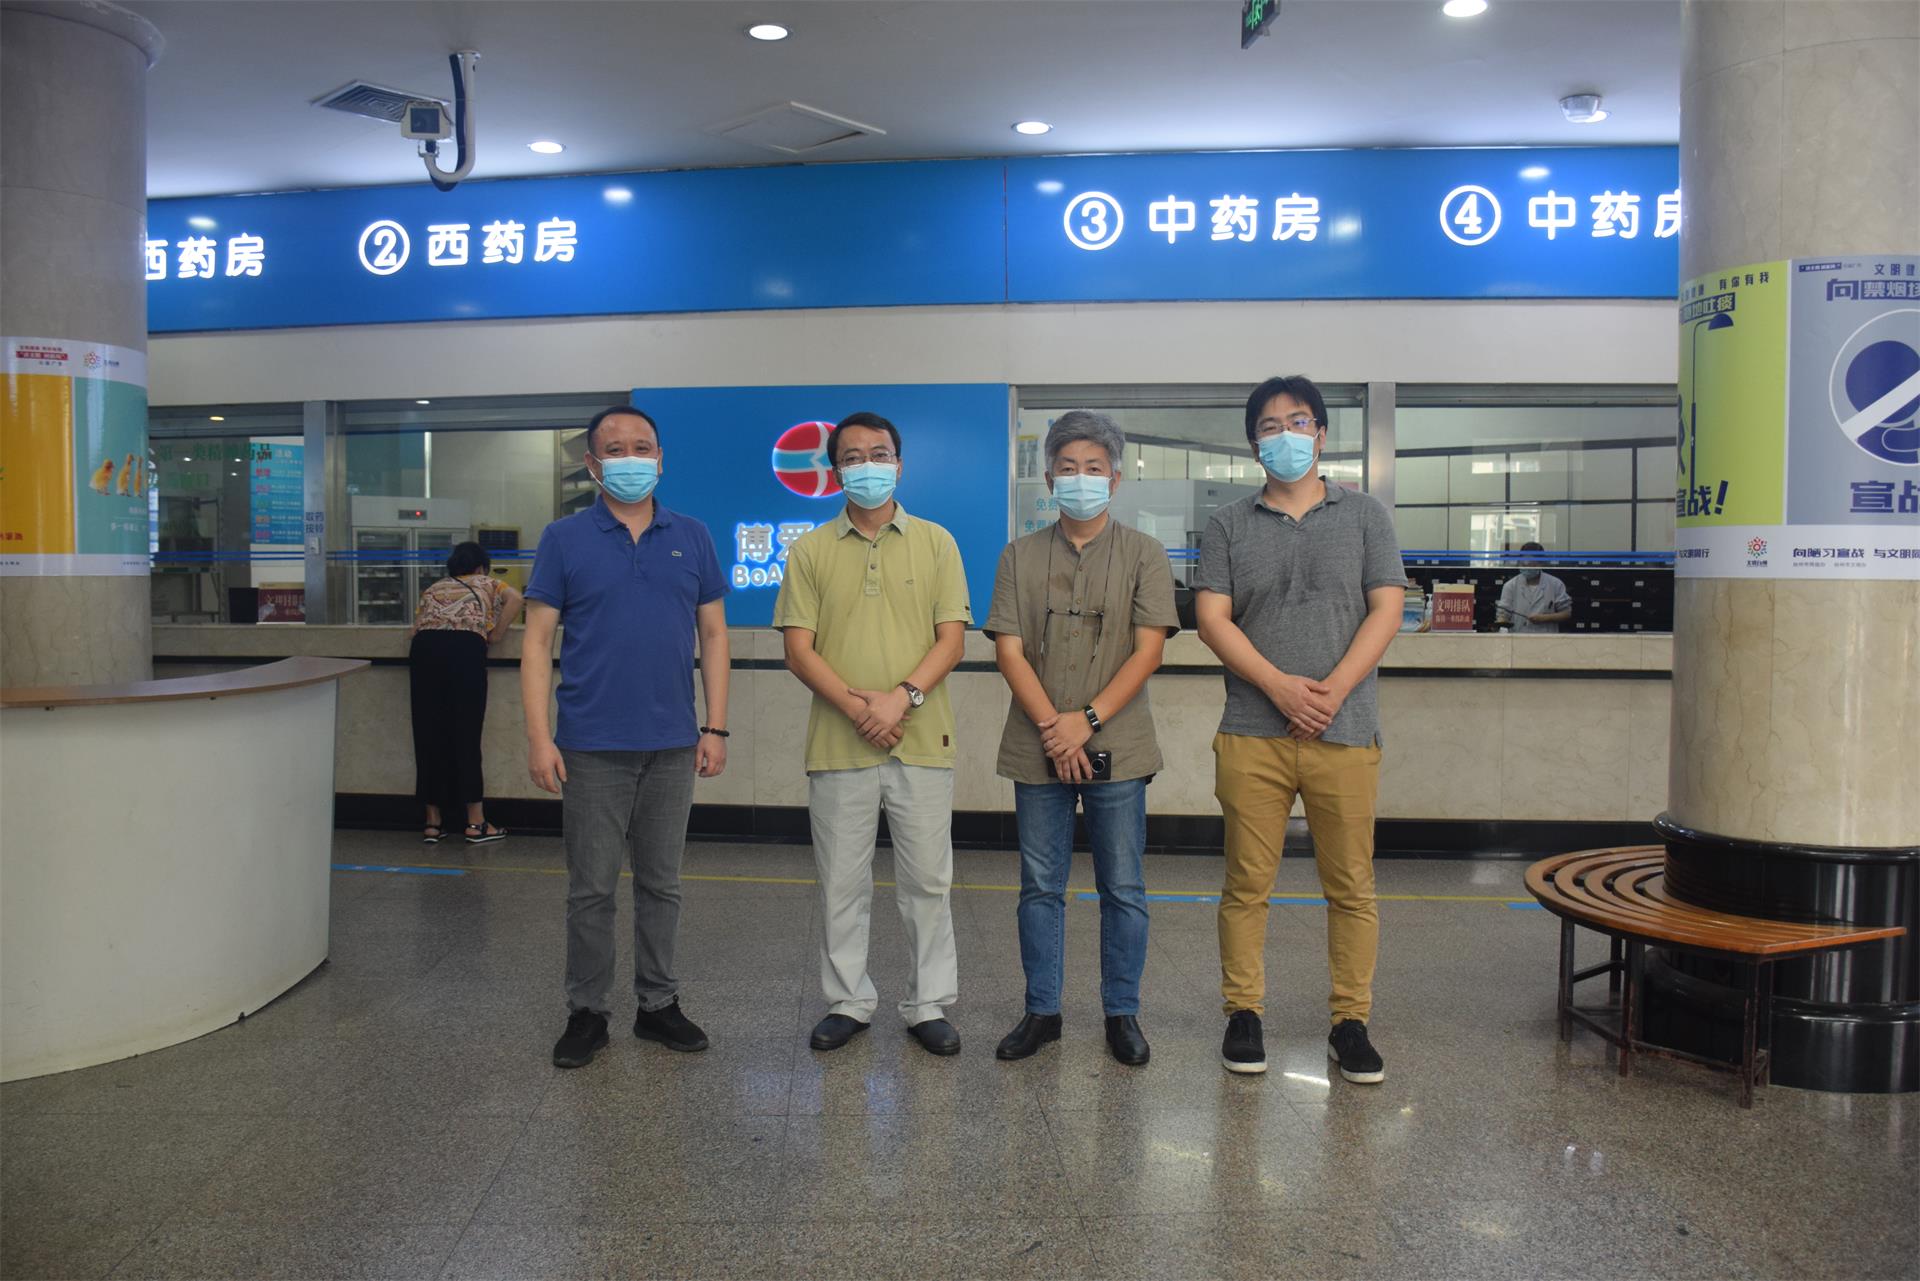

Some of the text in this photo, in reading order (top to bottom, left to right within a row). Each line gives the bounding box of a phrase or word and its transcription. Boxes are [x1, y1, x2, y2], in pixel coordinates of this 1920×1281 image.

[1148, 192, 1321, 243] 中药房
[145, 233, 265, 280] 西药房
[427, 217, 578, 267] 西药房
[1793, 547, 1865, 559] 向陋习宣战
[1437, 598, 1471, 612] 文明排队
